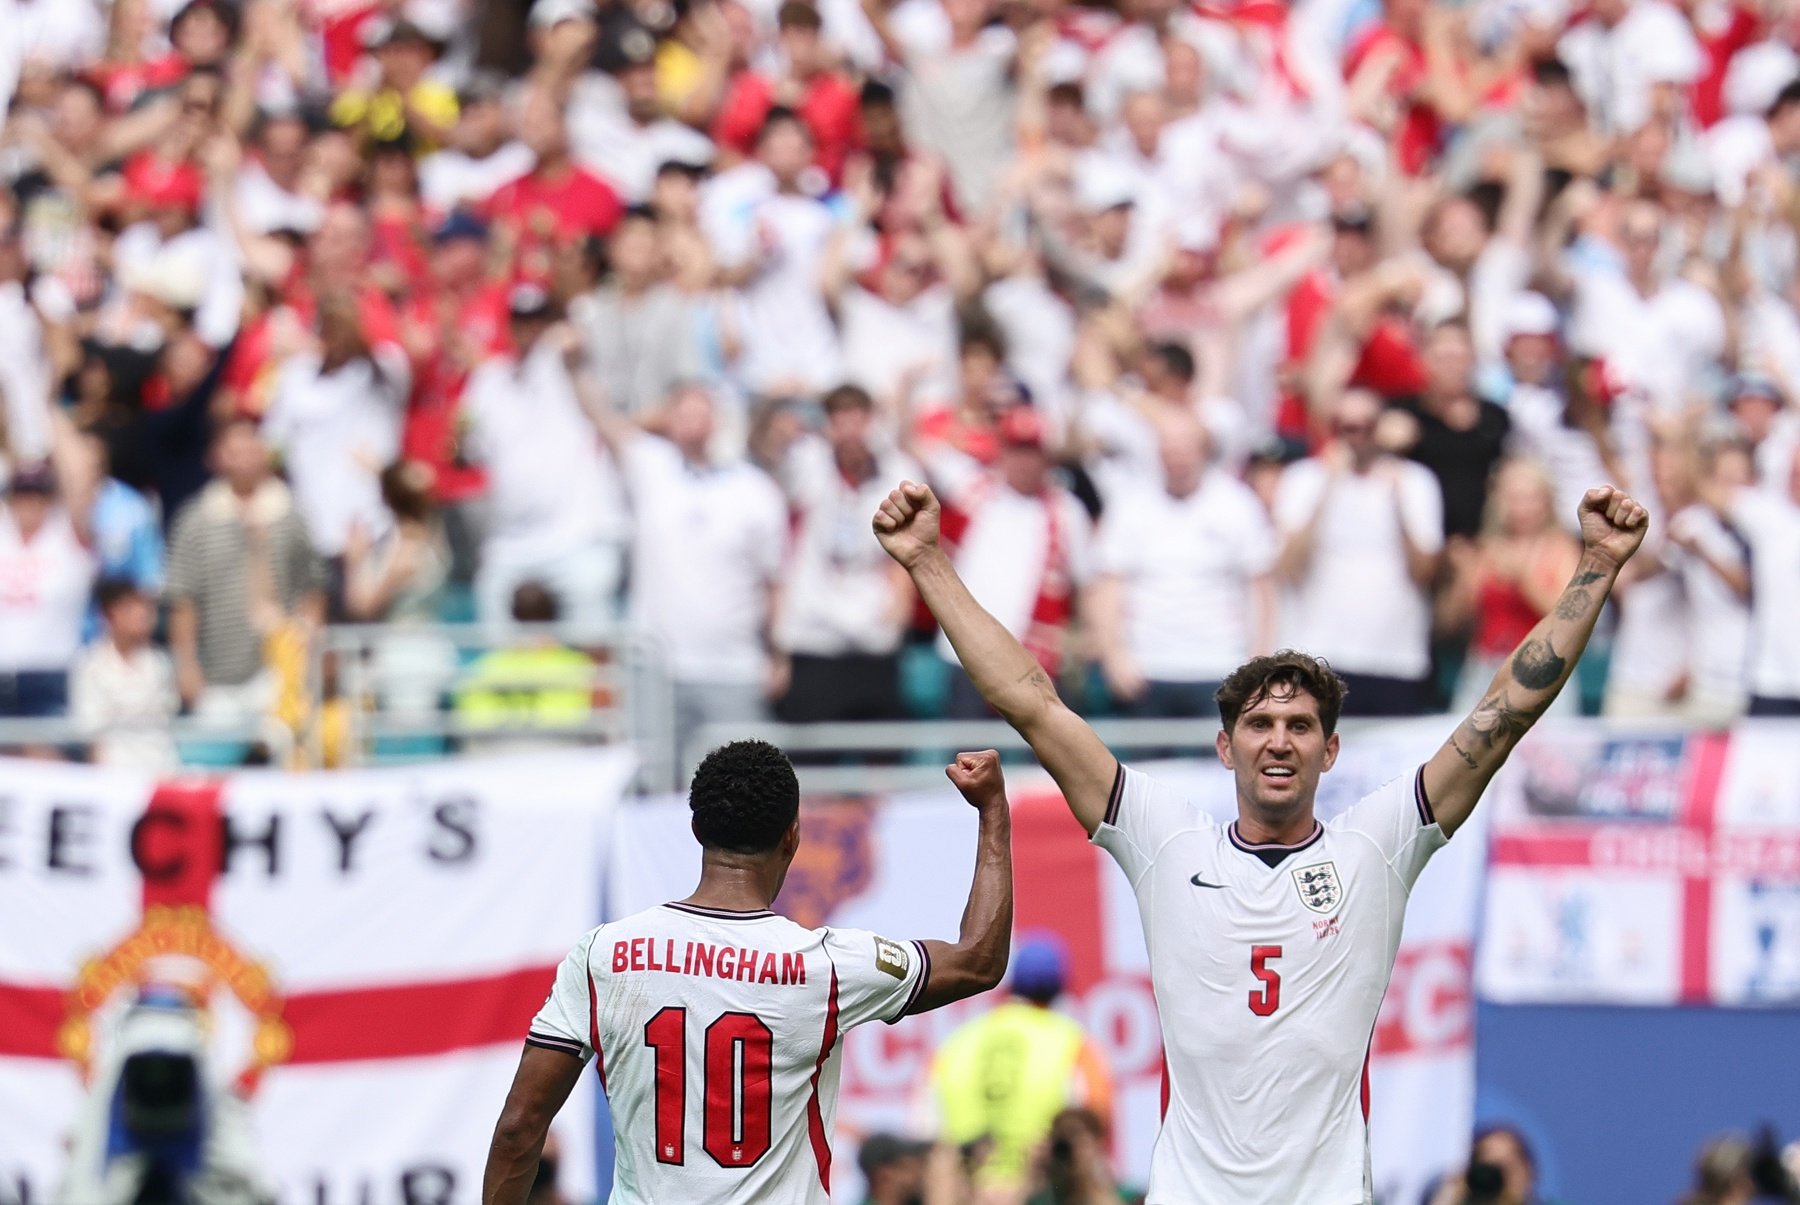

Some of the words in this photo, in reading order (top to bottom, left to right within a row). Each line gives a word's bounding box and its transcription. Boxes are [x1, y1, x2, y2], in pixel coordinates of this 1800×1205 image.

[612, 937, 806, 985] BELLINGHAM
[1248, 945, 1282, 1016] 5
[644, 1006, 773, 1168] 10
